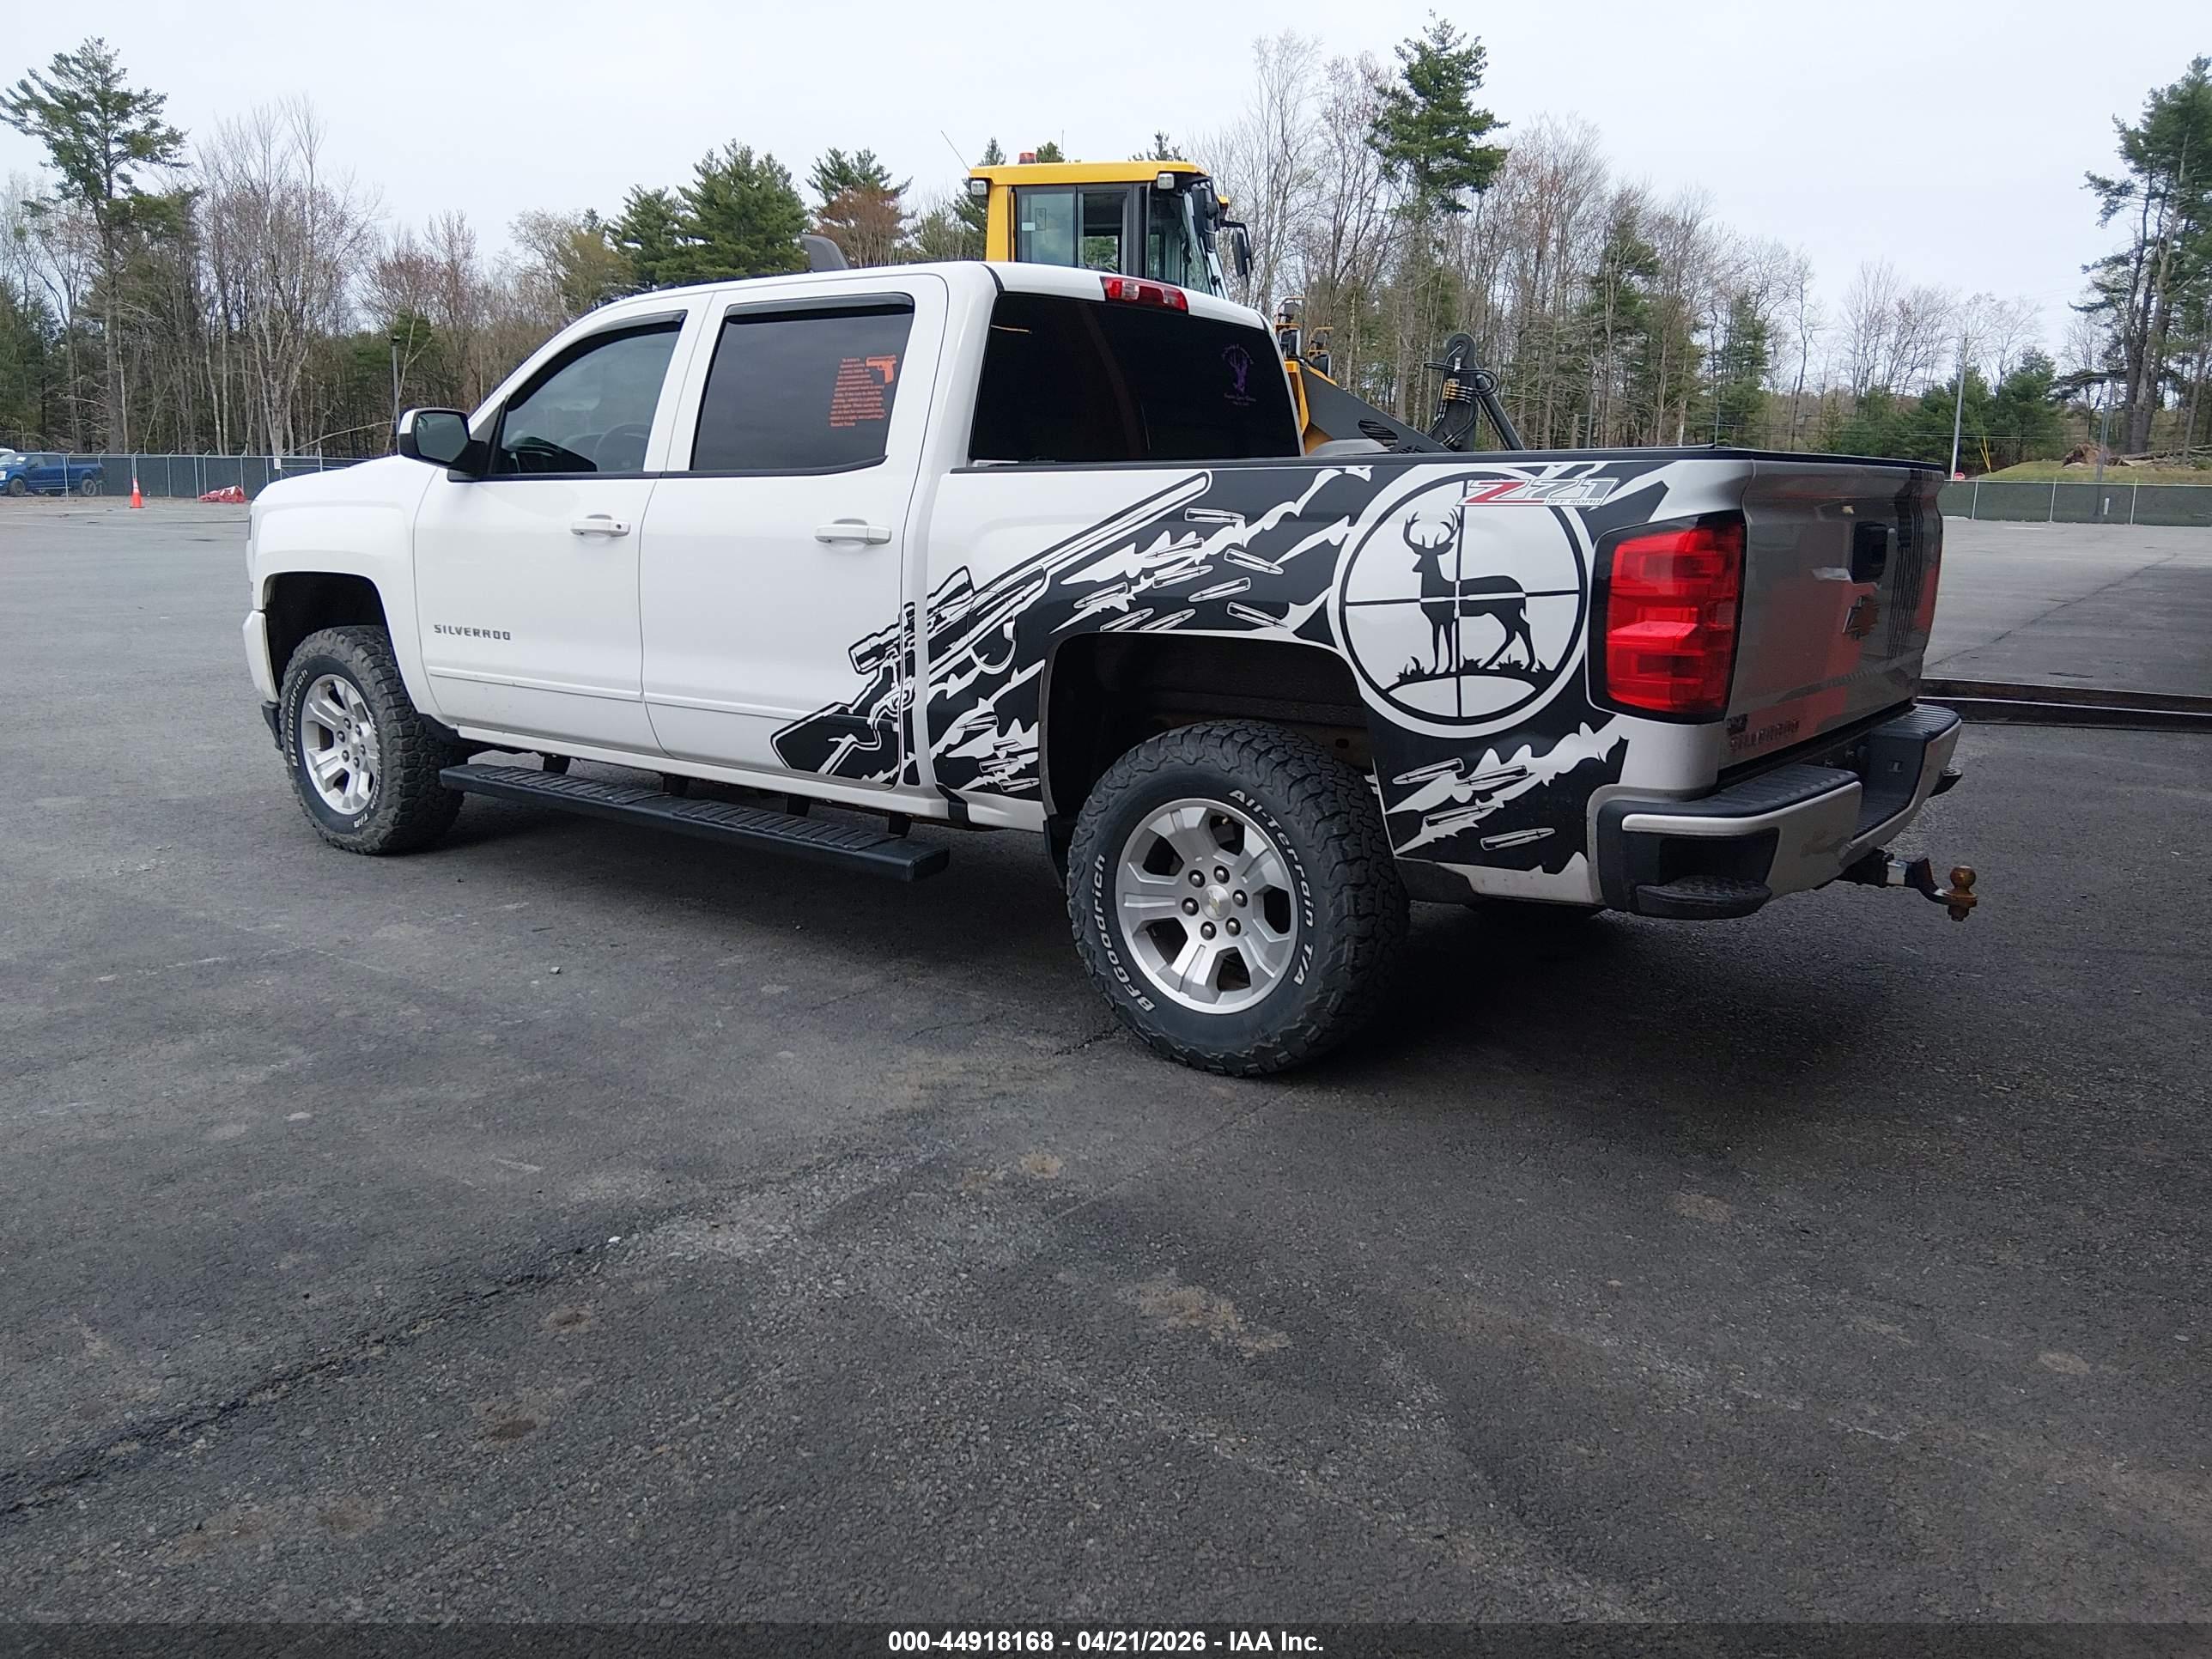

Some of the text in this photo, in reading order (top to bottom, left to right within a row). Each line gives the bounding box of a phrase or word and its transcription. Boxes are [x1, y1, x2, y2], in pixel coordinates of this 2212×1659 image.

[1457, 478, 1620, 506] Z71
[434, 624, 511, 641] SILVERADO
[287, 669, 308, 767] BFGoodrich
[354, 811, 369, 829] T/A
[1229, 789, 1314, 986] All-Terrain T/A
[1091, 854, 1156, 1012] BFGoodrich
